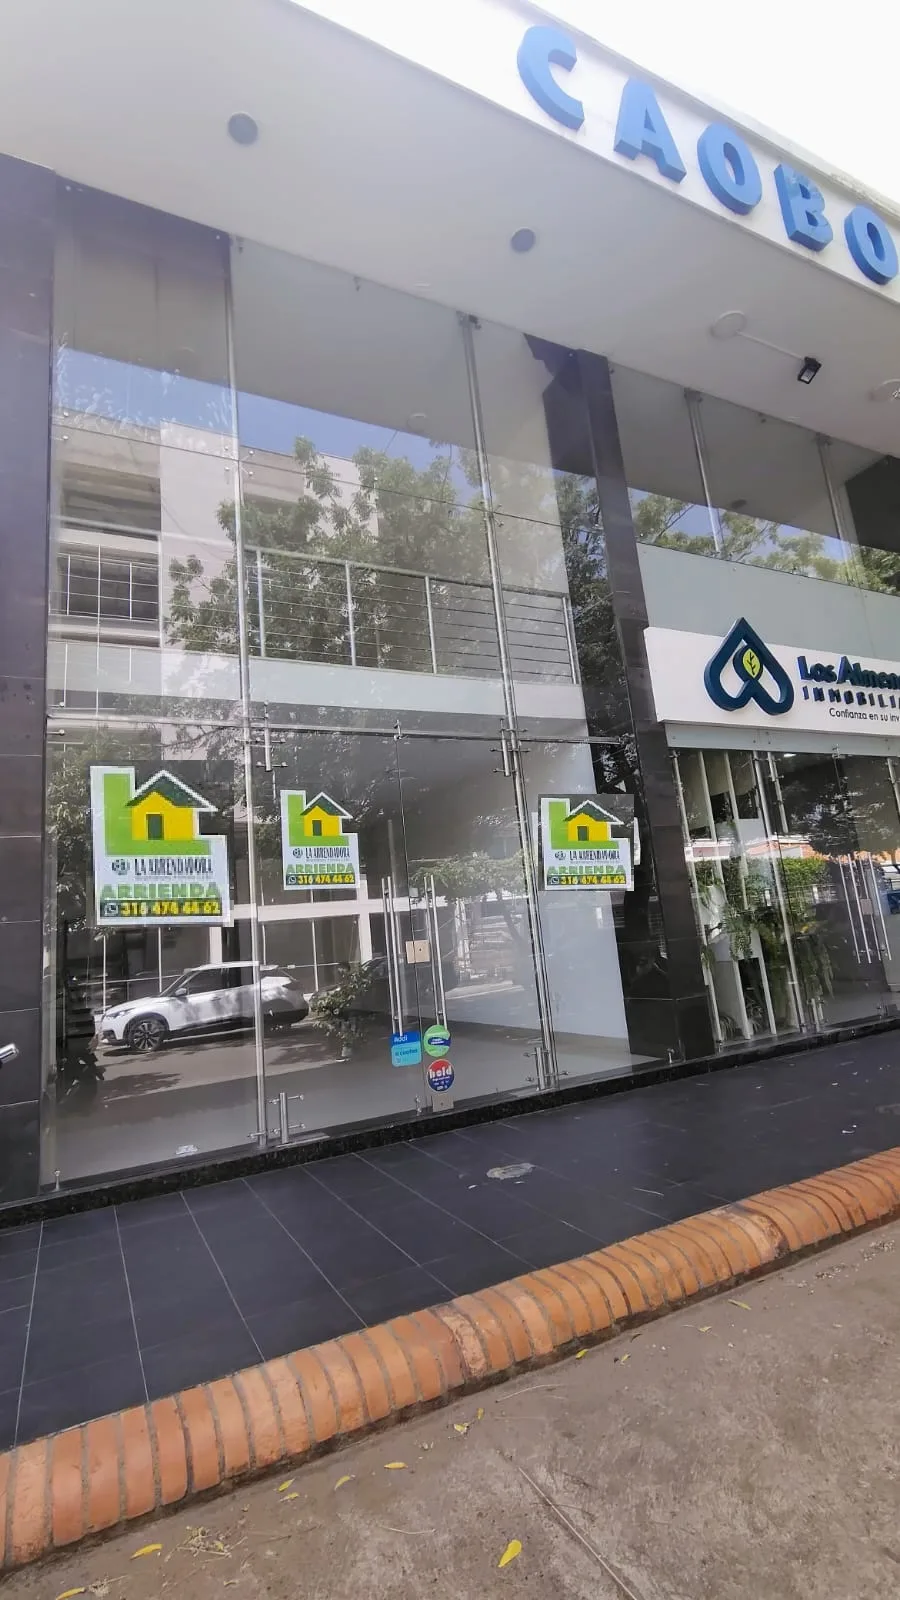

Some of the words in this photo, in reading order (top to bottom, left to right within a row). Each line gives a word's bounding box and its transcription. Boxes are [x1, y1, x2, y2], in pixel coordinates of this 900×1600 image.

[516, 24, 900, 286] CAOBO
[797, 656, 837, 682] Los
[803, 686, 900, 709] INMOBILI
[829, 708, 868, 720] Confianza
[869, 713, 879, 721] en
[305, 847, 313, 859] LA
[569, 850, 578, 861] LA
[135, 858, 147, 876] LA
[286, 863, 354, 873] ARRIENDA
[547, 865, 625, 874] ARRIENDA
[297, 875, 313, 885] 316
[561, 876, 578, 885] 316
[101, 883, 220, 898] ARRIENDA
[121, 902, 148, 915] 316
